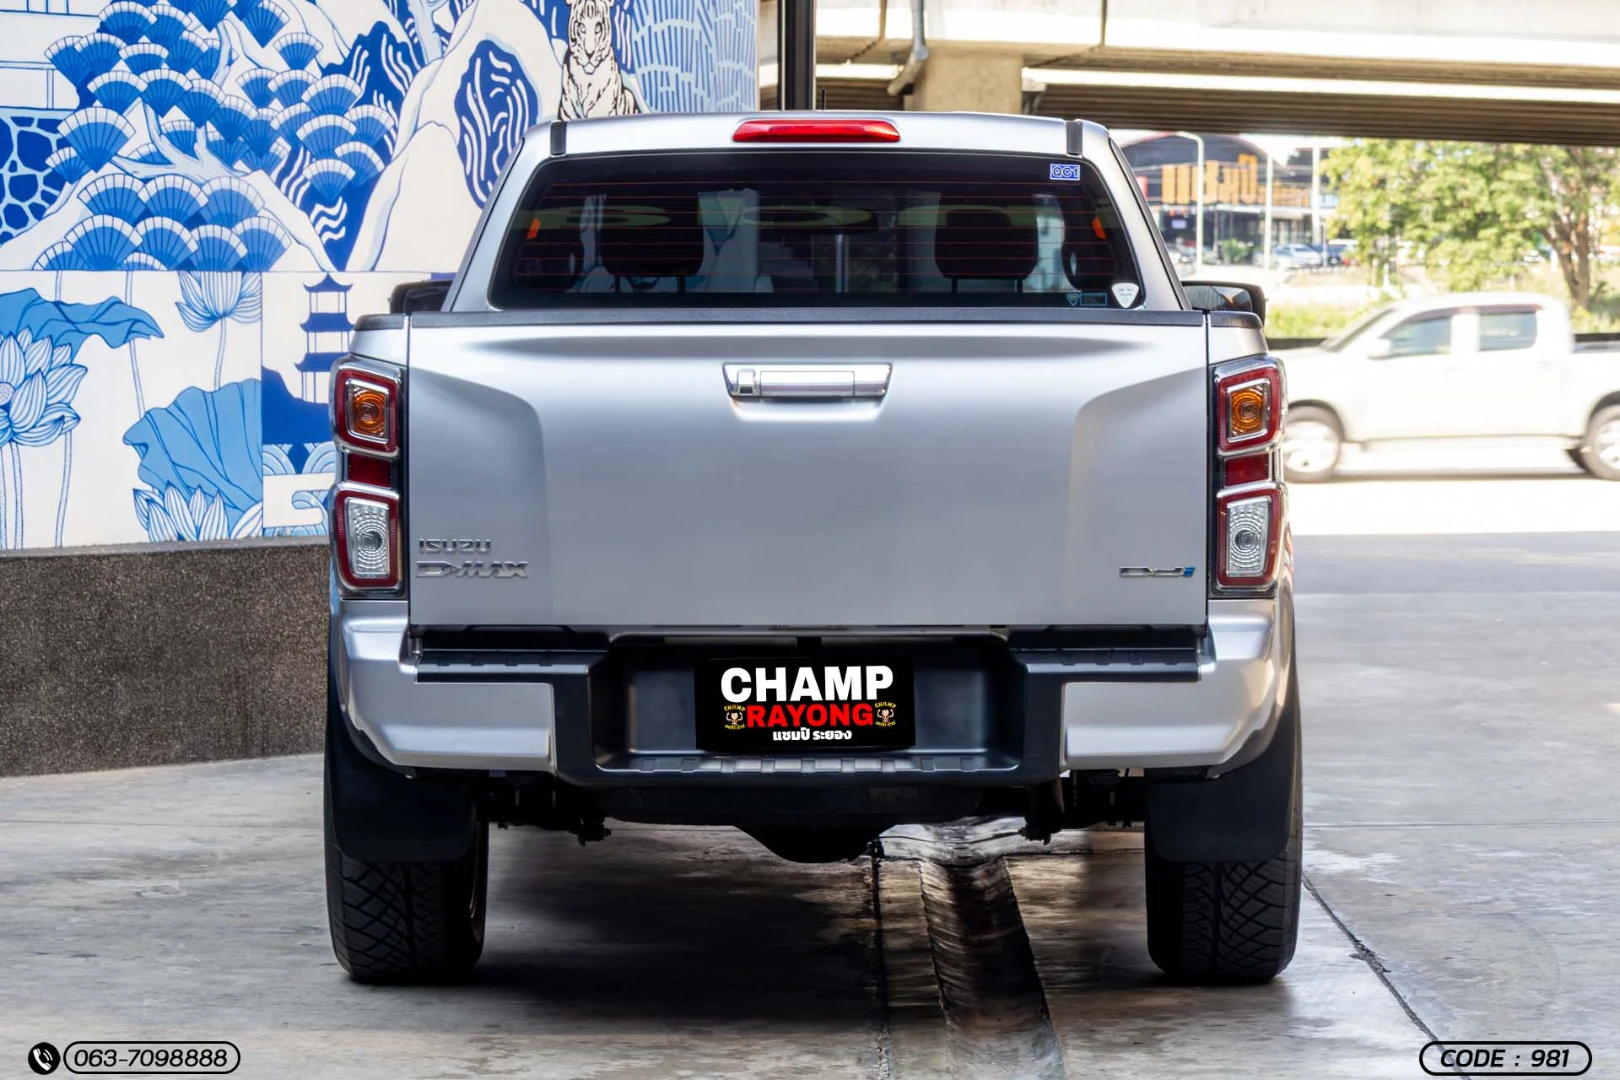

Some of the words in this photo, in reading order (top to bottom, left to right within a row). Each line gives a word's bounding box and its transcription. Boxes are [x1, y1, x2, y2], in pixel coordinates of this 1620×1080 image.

[1053, 166, 1078, 177] QC1
[419, 538, 491, 554] ISUZU
[416, 560, 529, 578] D-MAX
[721, 665, 894, 703] CHAMP
[747, 703, 873, 728] RAYONG
[812, 730, 853, 740] ระยอง
